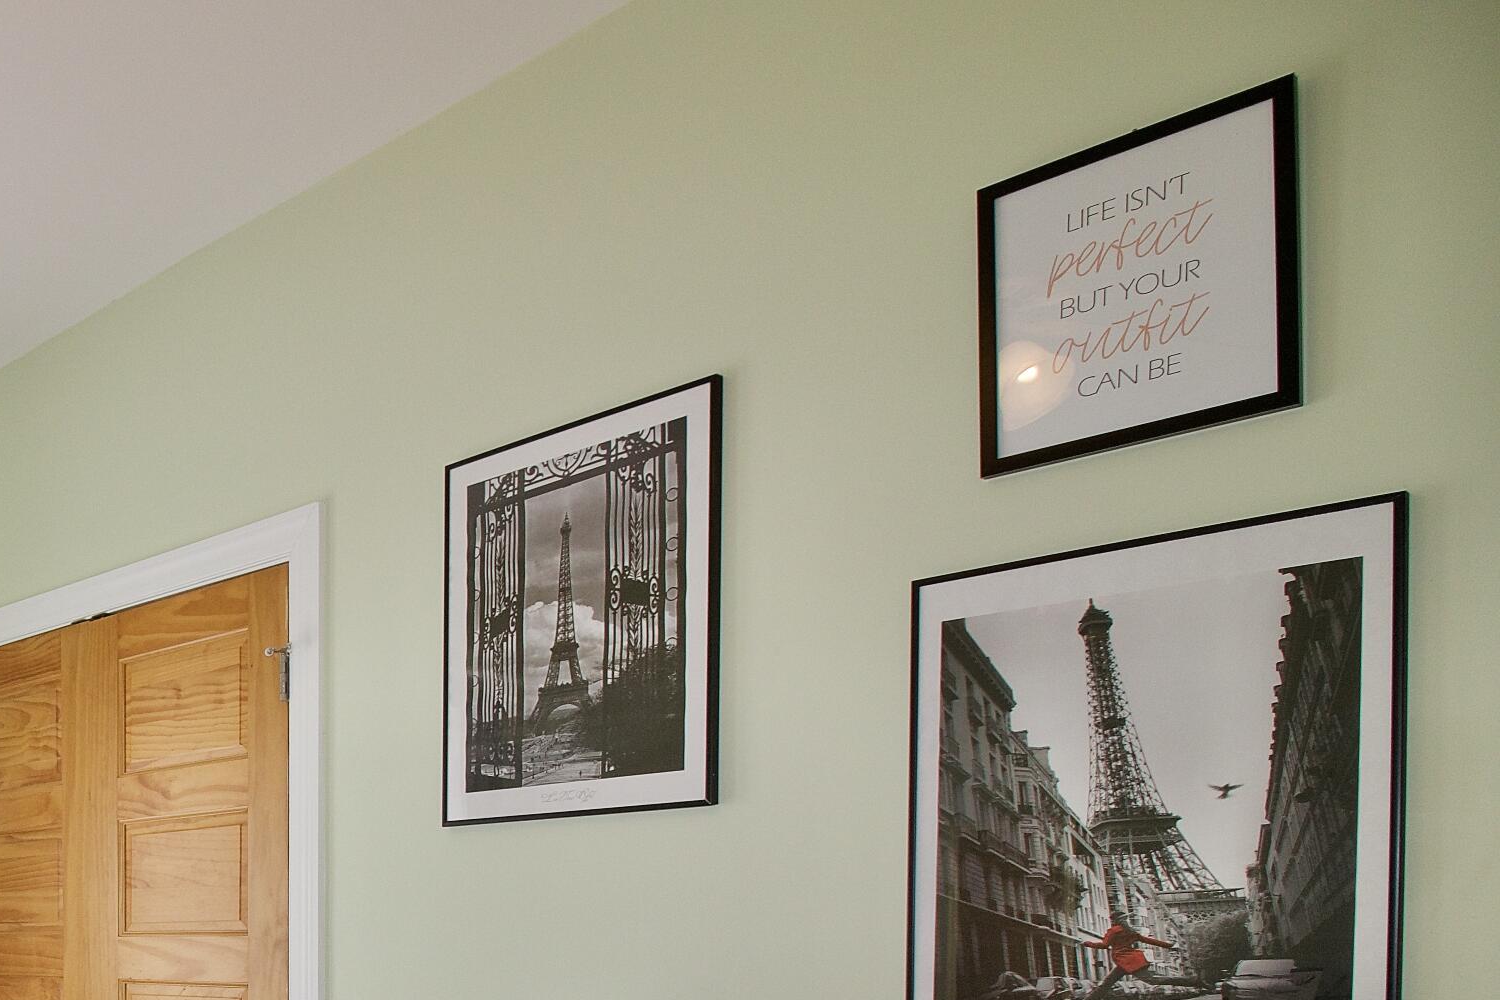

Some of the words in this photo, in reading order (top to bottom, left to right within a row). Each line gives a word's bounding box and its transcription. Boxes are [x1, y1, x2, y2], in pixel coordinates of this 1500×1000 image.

[1066, 196, 1117, 233] LIFE
[1125, 171, 1191, 214] ISN'T
[1046, 198, 1214, 298] perfect
[1059, 284, 1114, 319] BUT
[1119, 258, 1201, 300] YOUR
[1052, 290, 1212, 374] outfit
[1077, 363, 1139, 398] CAN
[1148, 351, 1184, 381] BE
